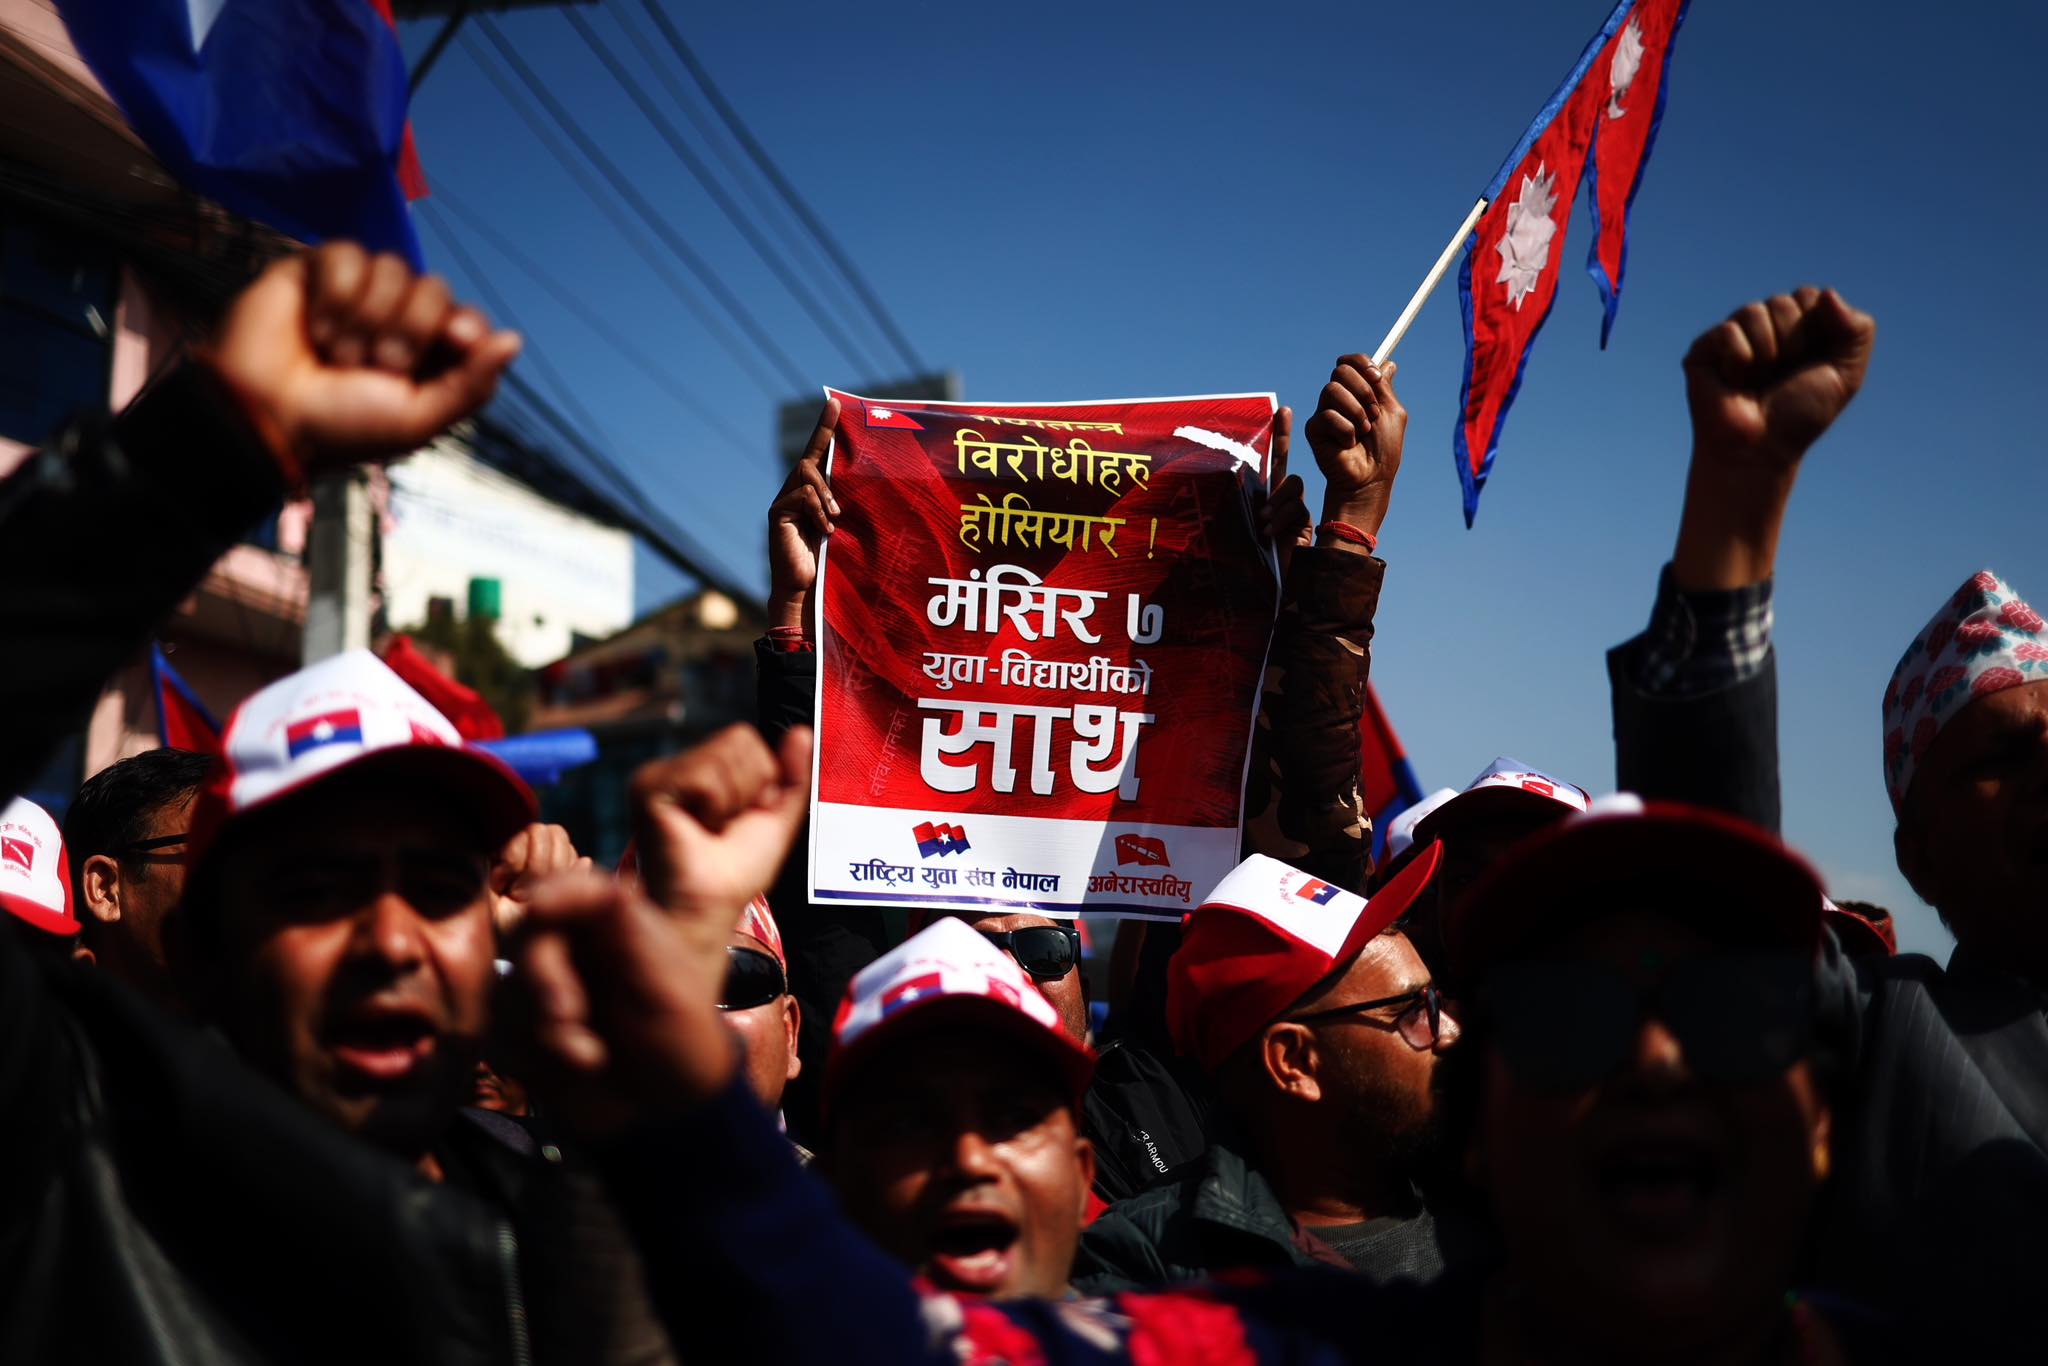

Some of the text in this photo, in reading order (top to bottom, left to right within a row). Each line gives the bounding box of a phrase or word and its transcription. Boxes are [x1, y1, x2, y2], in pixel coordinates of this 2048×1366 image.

[953, 428, 1152, 496] विरोधीहरु
[959, 493, 1126, 558] होसियार
[926, 564, 1164, 644] मंसिर ७
[917, 697, 1155, 801] साथ
[849, 858, 1061, 893] राष्ट्रिय युवा संघ नेपाल
[1087, 870, 1193, 903] अनेरास्ववियु
[1145, 1142, 1169, 1173] ARMOU
